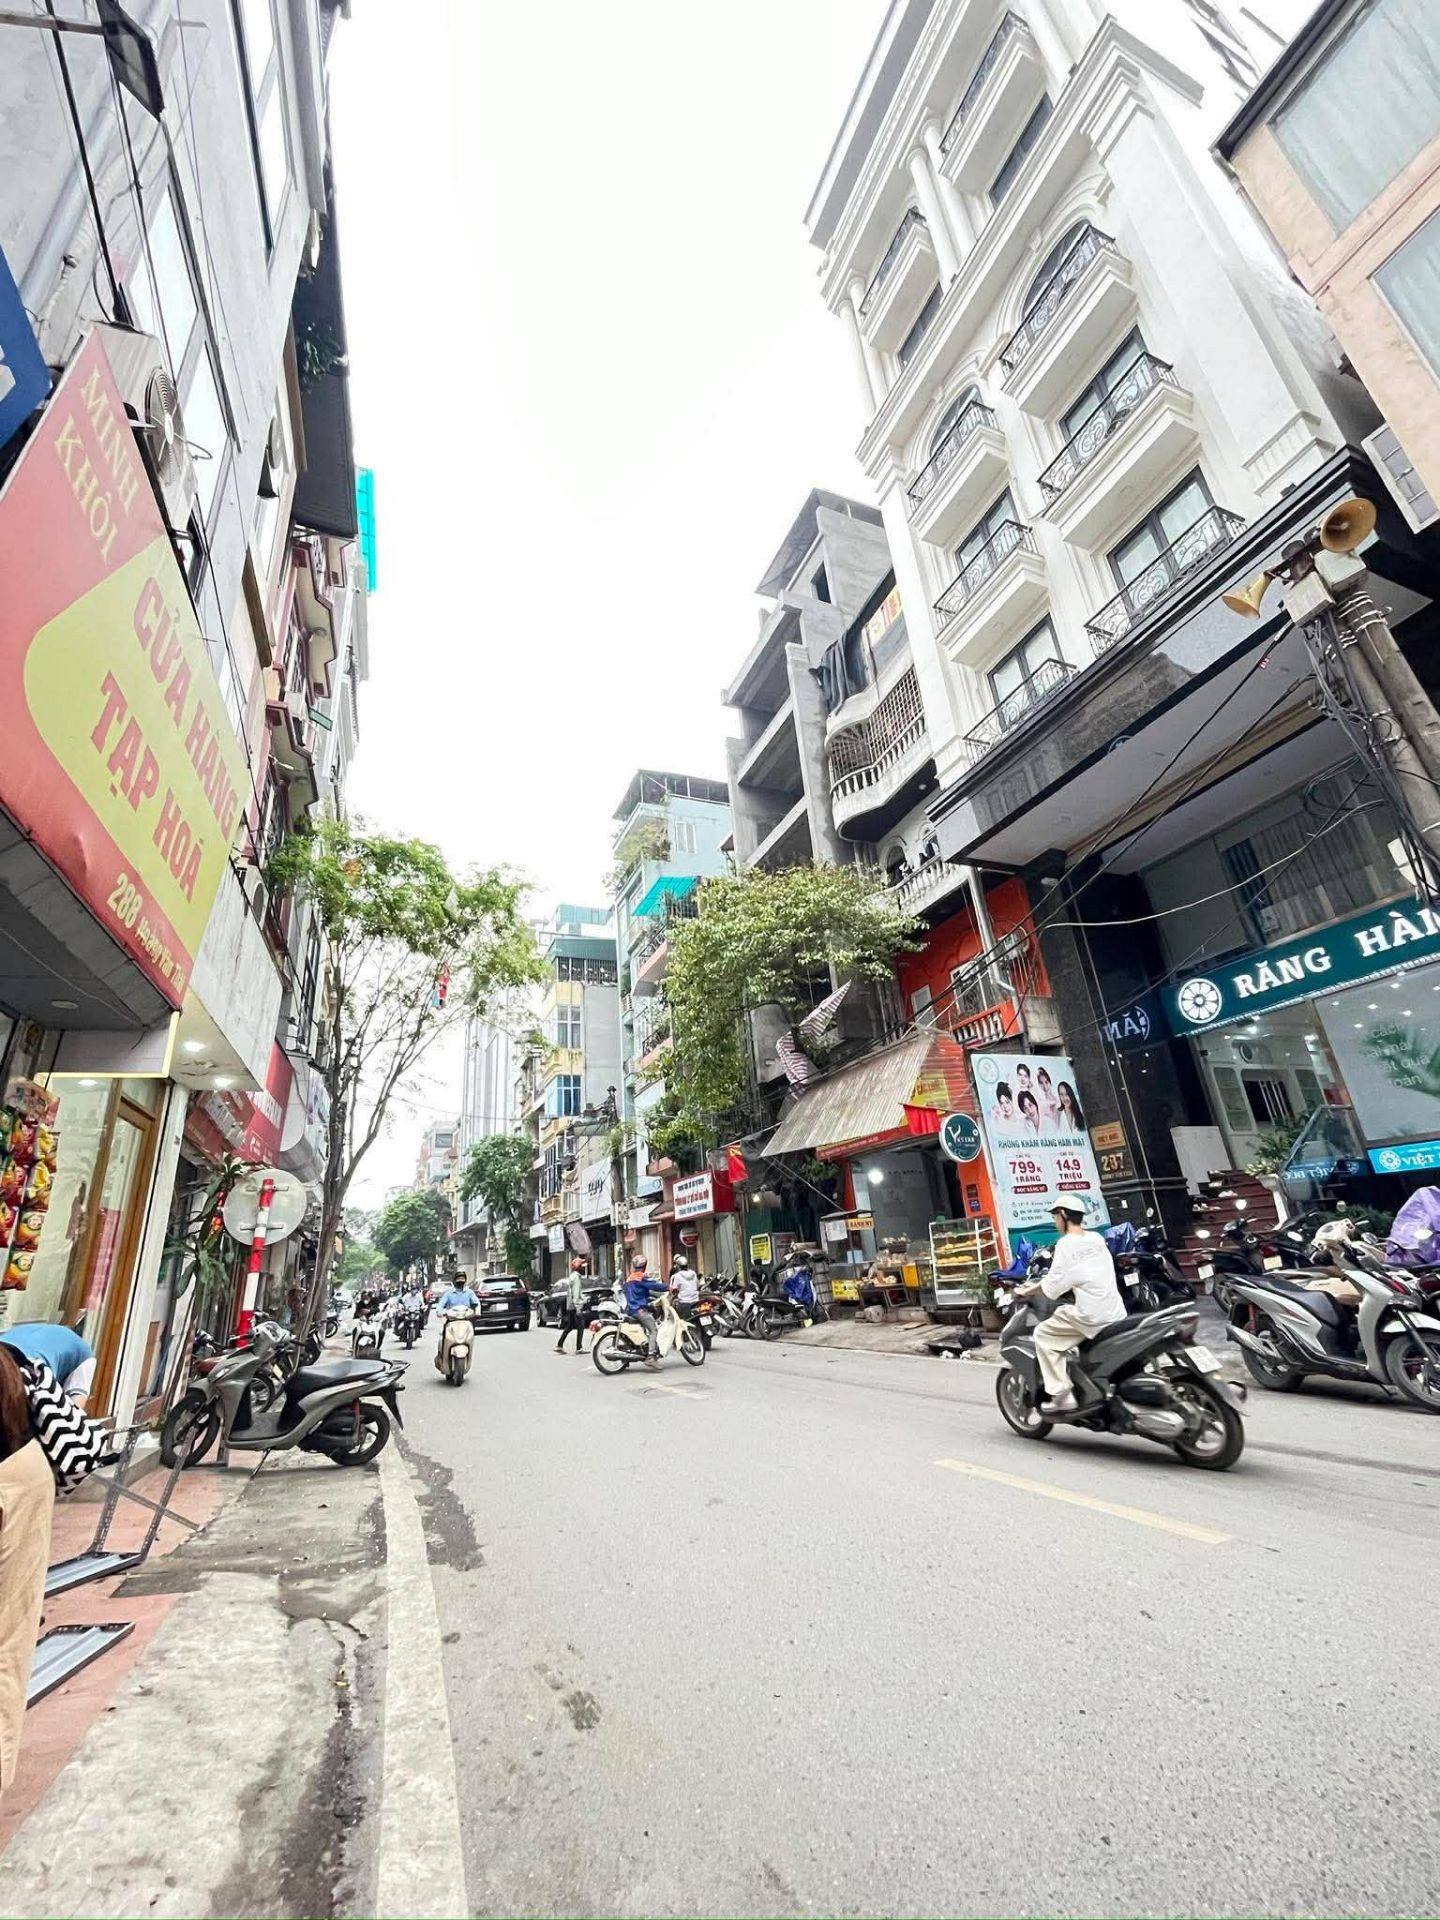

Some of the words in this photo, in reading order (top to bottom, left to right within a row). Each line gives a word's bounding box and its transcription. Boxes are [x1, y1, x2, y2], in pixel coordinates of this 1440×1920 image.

[81, 363, 139, 518] MINH
[134, 577, 192, 730] CỬA
[184, 699, 237, 844] HÀNG
[90, 669, 160, 813] TẠP
[106, 872, 144, 929] 288
[1233, 947, 1332, 999] RĂNG
[1056, 1159, 1081, 1172] 14.9
[1059, 1172, 1082, 1181] TRIỆU
[1401, 1152, 1436, 1166] VIỆT
